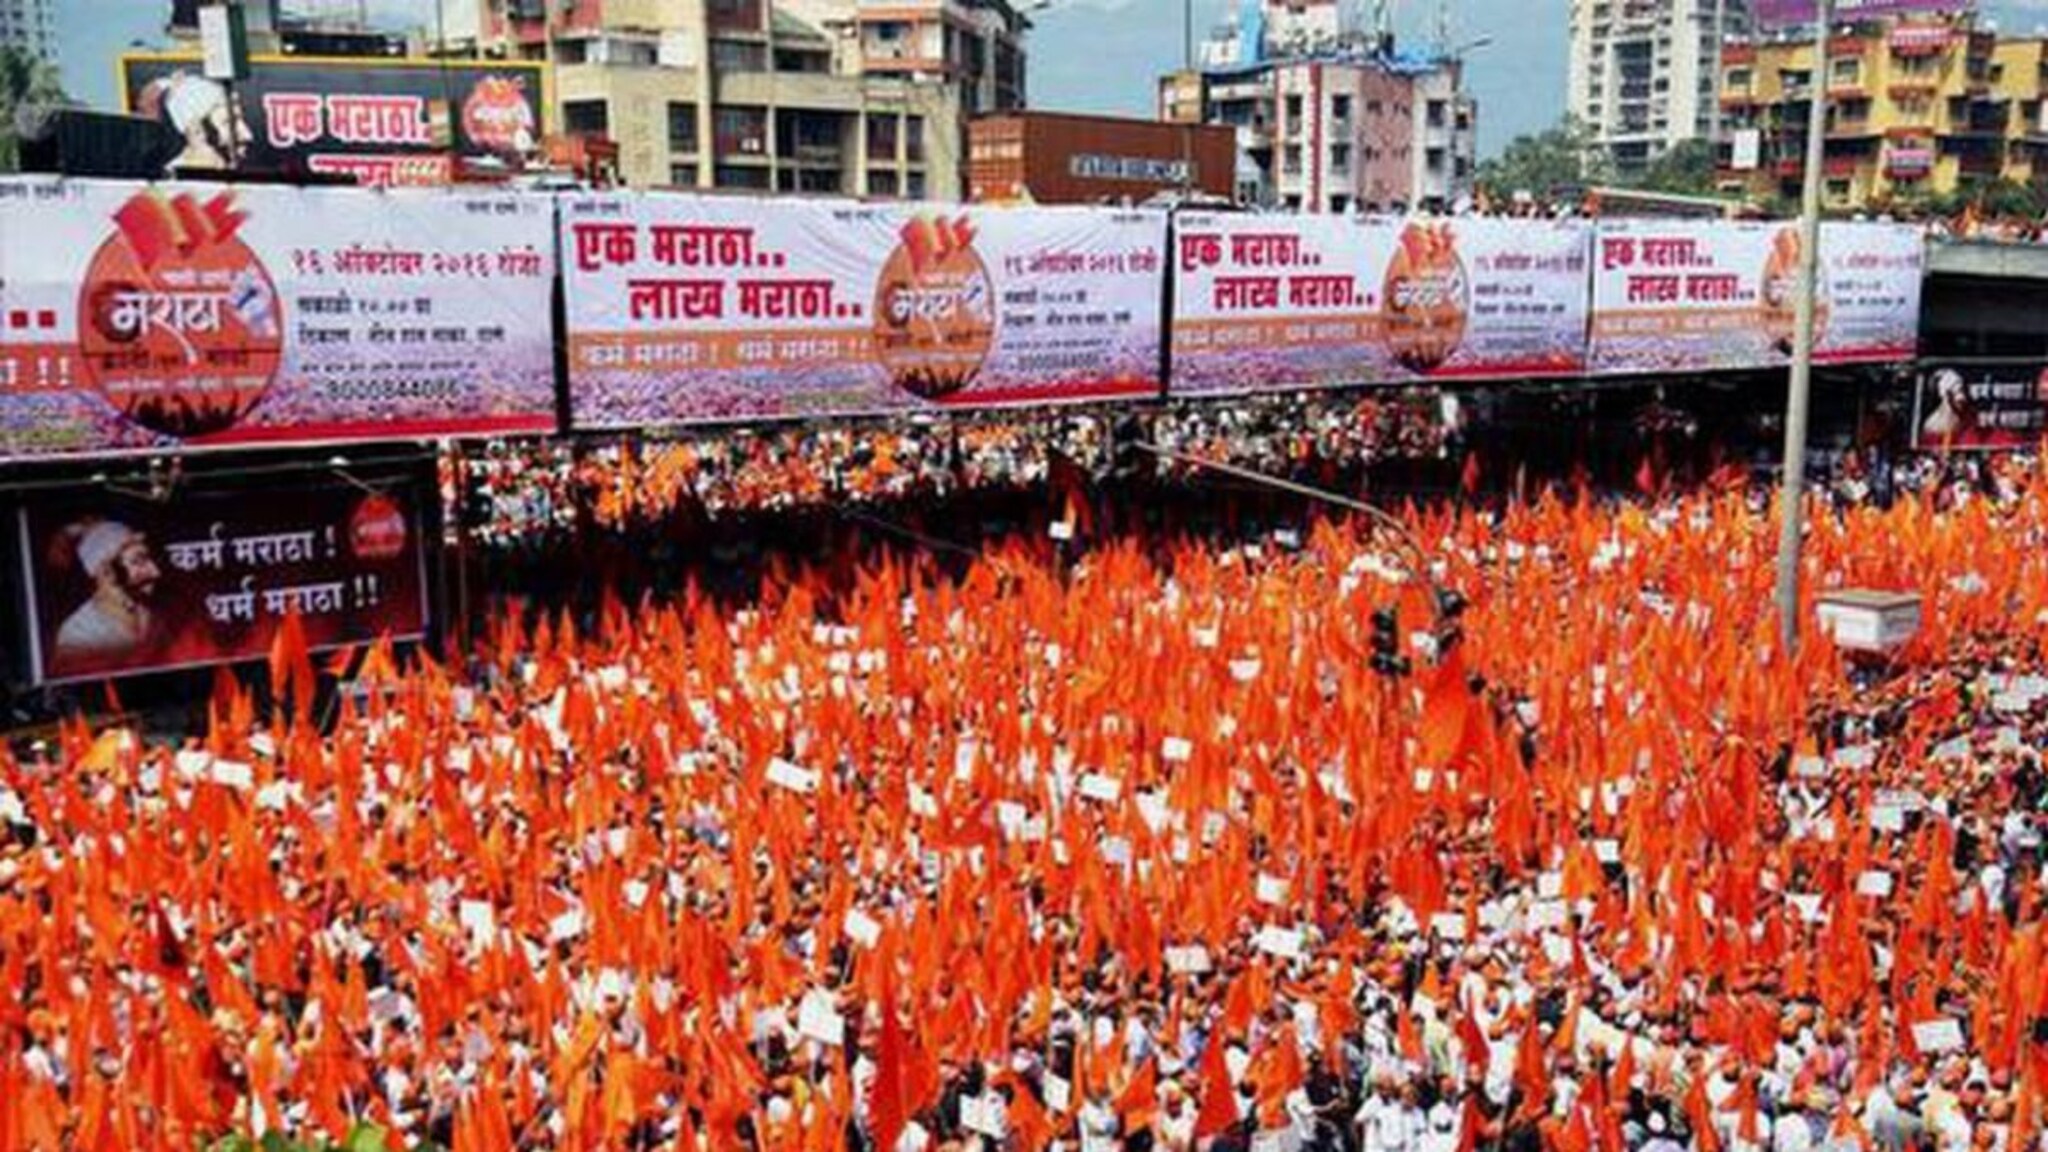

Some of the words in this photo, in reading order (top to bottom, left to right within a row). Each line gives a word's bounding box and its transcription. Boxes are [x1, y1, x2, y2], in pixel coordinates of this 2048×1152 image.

[263, 93, 322, 148] एक
[432, 251, 490, 277] २०१६
[572, 224, 636, 271] एक
[649, 227, 786, 267] मराठा..
[1180, 234, 1222, 271] एक
[1230, 234, 1321, 266] मराठा..
[1602, 238, 1635, 270] एक
[627, 279, 725, 319] लाख
[737, 279, 863, 318] मराठा..
[1213, 276, 1280, 310] लाख
[1289, 275, 1374, 307] मराठा..
[110, 290, 228, 345] मराठा
[166, 522, 225, 572] कर्म
[232, 531, 314, 566] मराठा
[325, 526, 336, 556] !
[205, 575, 254, 623] धर्म
[265, 580, 344, 616] मराठा
[353, 575, 379, 607] !!
